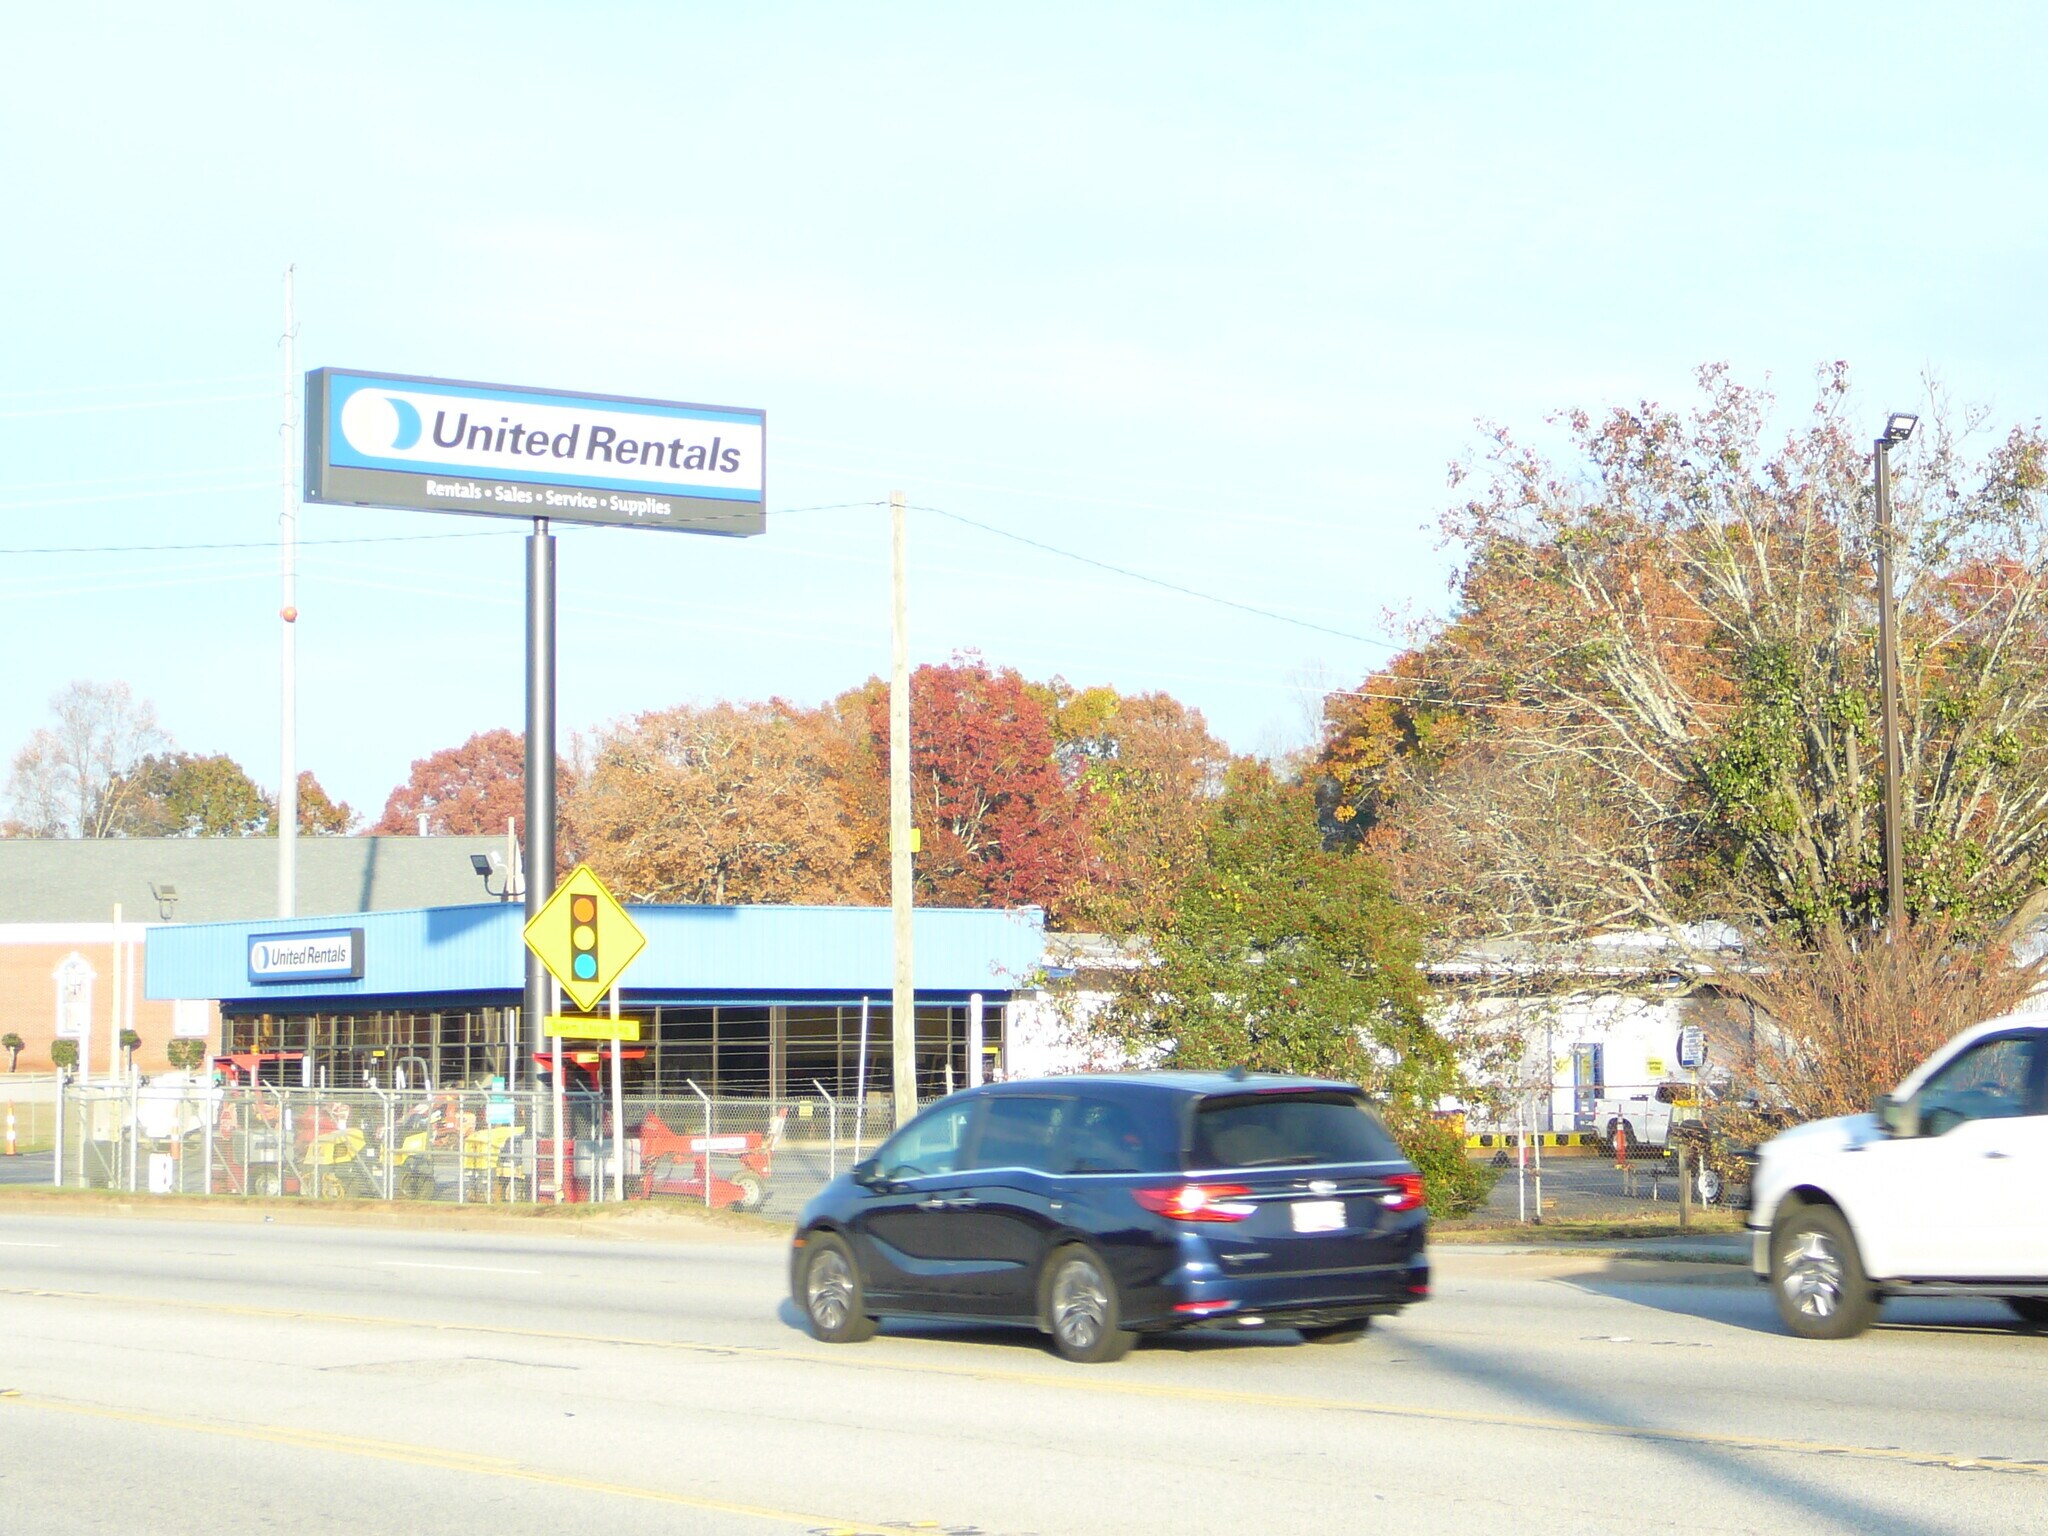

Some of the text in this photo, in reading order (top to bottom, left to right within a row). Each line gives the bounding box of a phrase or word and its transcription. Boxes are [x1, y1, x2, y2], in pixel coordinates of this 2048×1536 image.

[432, 410, 741, 473] United Rentals
[426, 480, 671, 516] Rentals Sales Service Supplies
[271, 944, 346, 966] United Rentals
